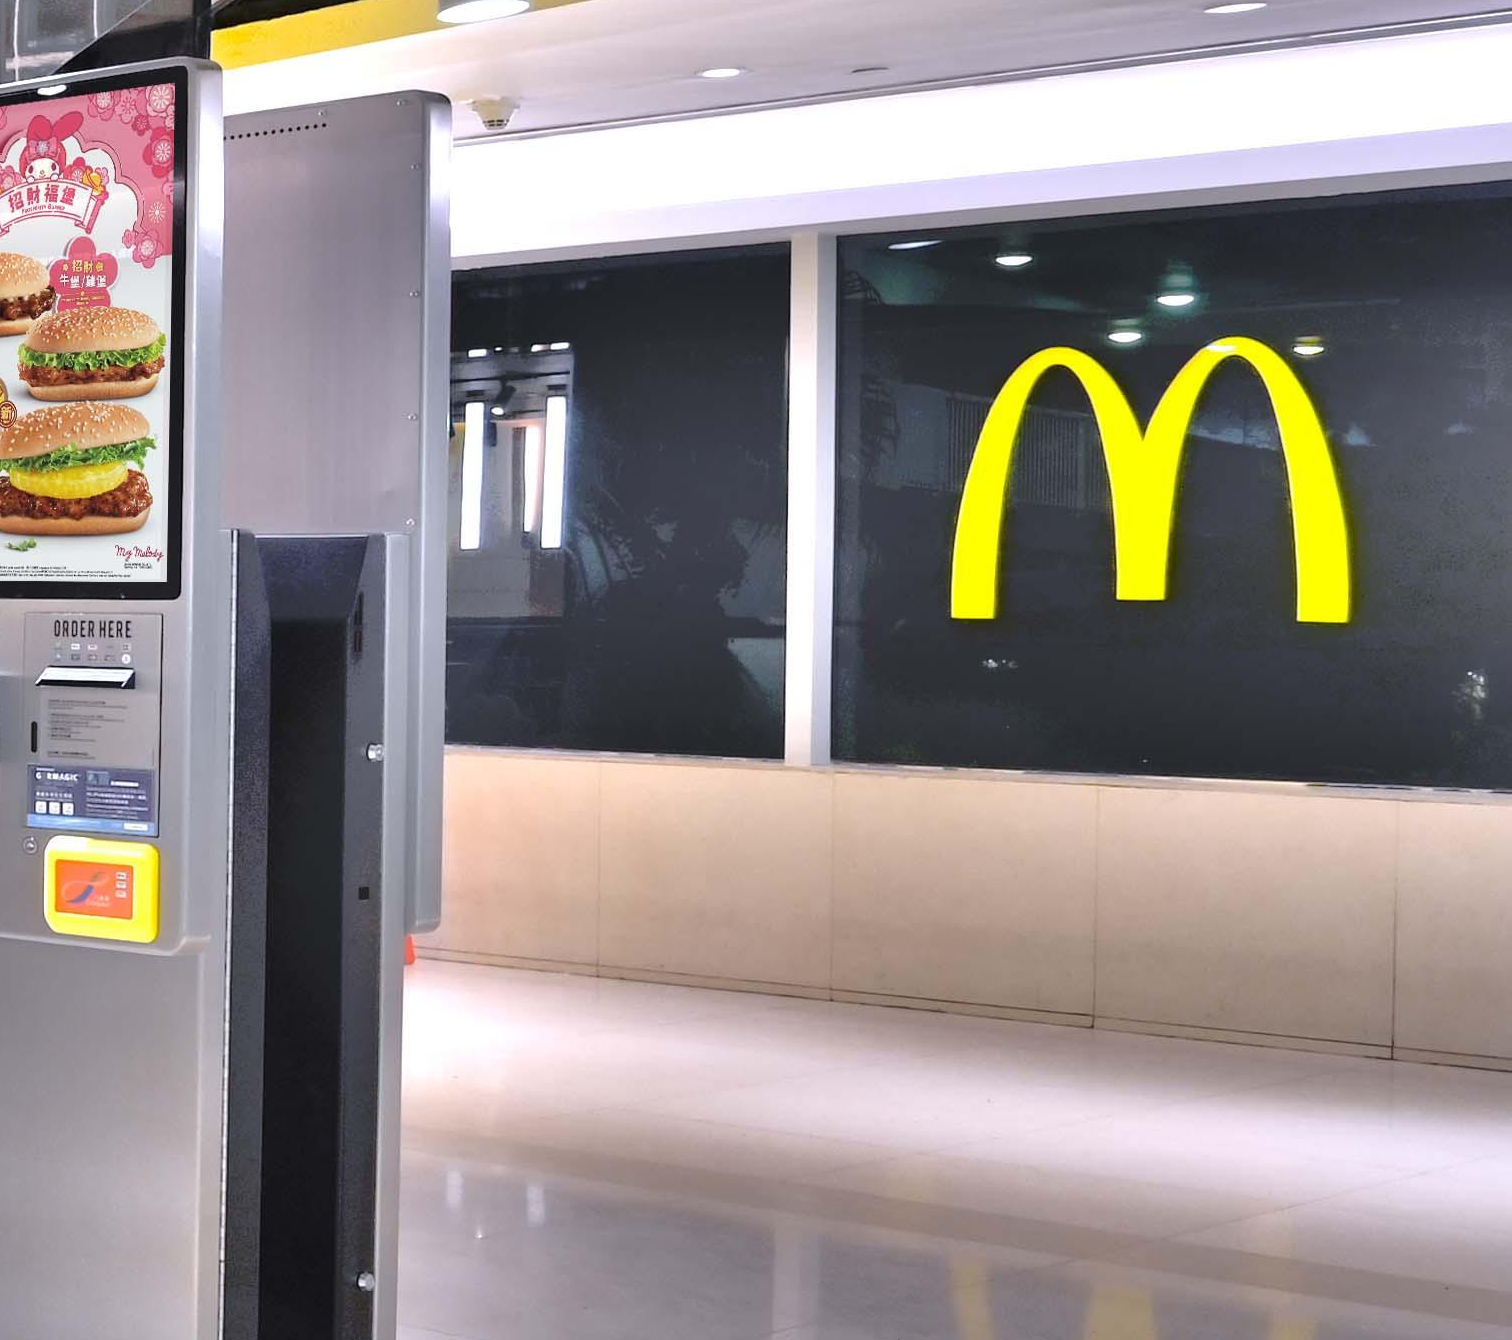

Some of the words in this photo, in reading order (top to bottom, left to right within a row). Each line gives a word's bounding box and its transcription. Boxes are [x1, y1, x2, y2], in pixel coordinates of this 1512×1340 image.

[8, 183, 76, 213] 招財福堡
[114, 544, 133, 562] My
[54, 619, 95, 638] ORDER
[99, 620, 133, 638] HERE
[35, 771, 79, 782] GRMAGIC
